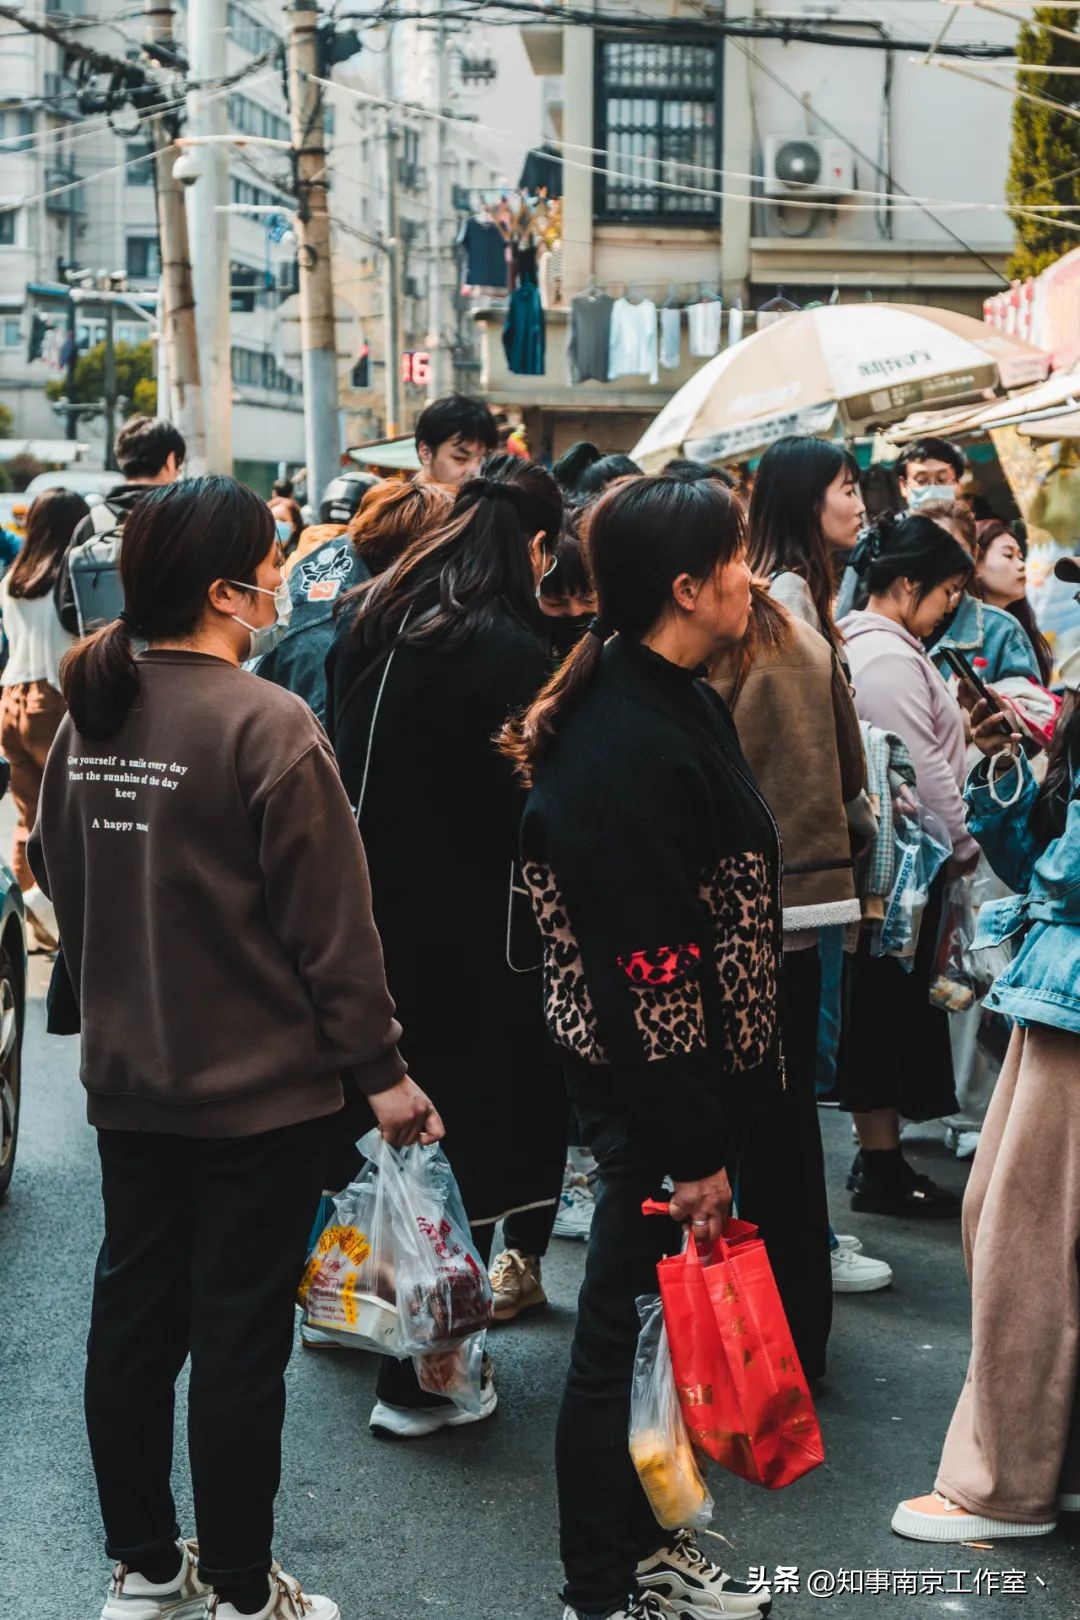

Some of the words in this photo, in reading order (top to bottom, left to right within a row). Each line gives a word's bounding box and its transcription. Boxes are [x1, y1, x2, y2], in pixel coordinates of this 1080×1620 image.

[402, 352, 432, 385] 16
[79, 756, 117, 766] yourself
[147, 761, 167, 772] every
[169, 762, 188, 775] day
[85, 770, 101, 780] the
[103, 772, 140, 783] sunshine
[140, 774, 148, 784] of
[149, 775, 160, 786] the
[161, 777, 179, 790] day
[115, 787, 137, 800] keep
[91, 818, 100, 829] A
[103, 818, 134, 831] happy
